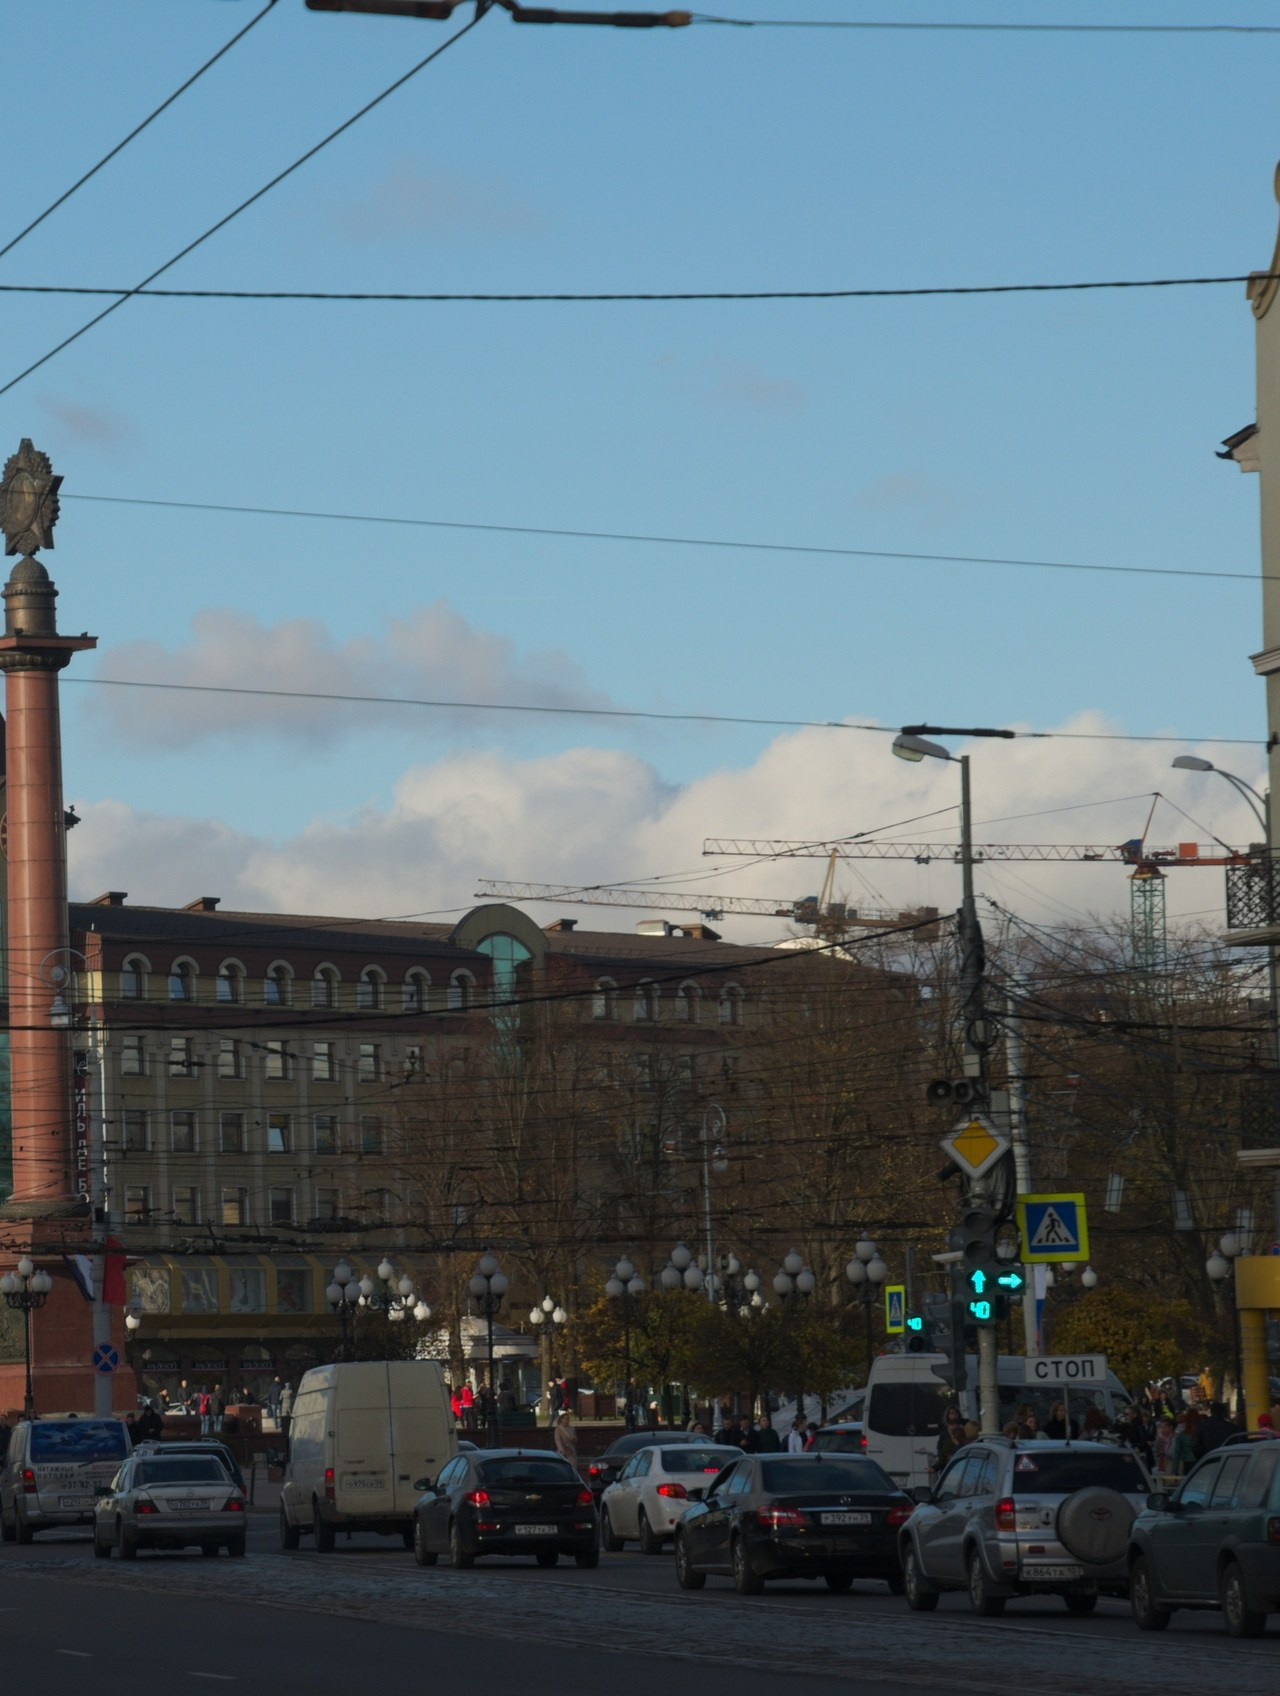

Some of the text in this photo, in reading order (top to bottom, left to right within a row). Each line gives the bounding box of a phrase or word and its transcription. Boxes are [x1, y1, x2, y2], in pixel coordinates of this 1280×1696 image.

[970, 1301, 990, 1319] 40
[907, 1317, 922, 1330] 40
[1035, 1360, 1095, 1379] СТОП
